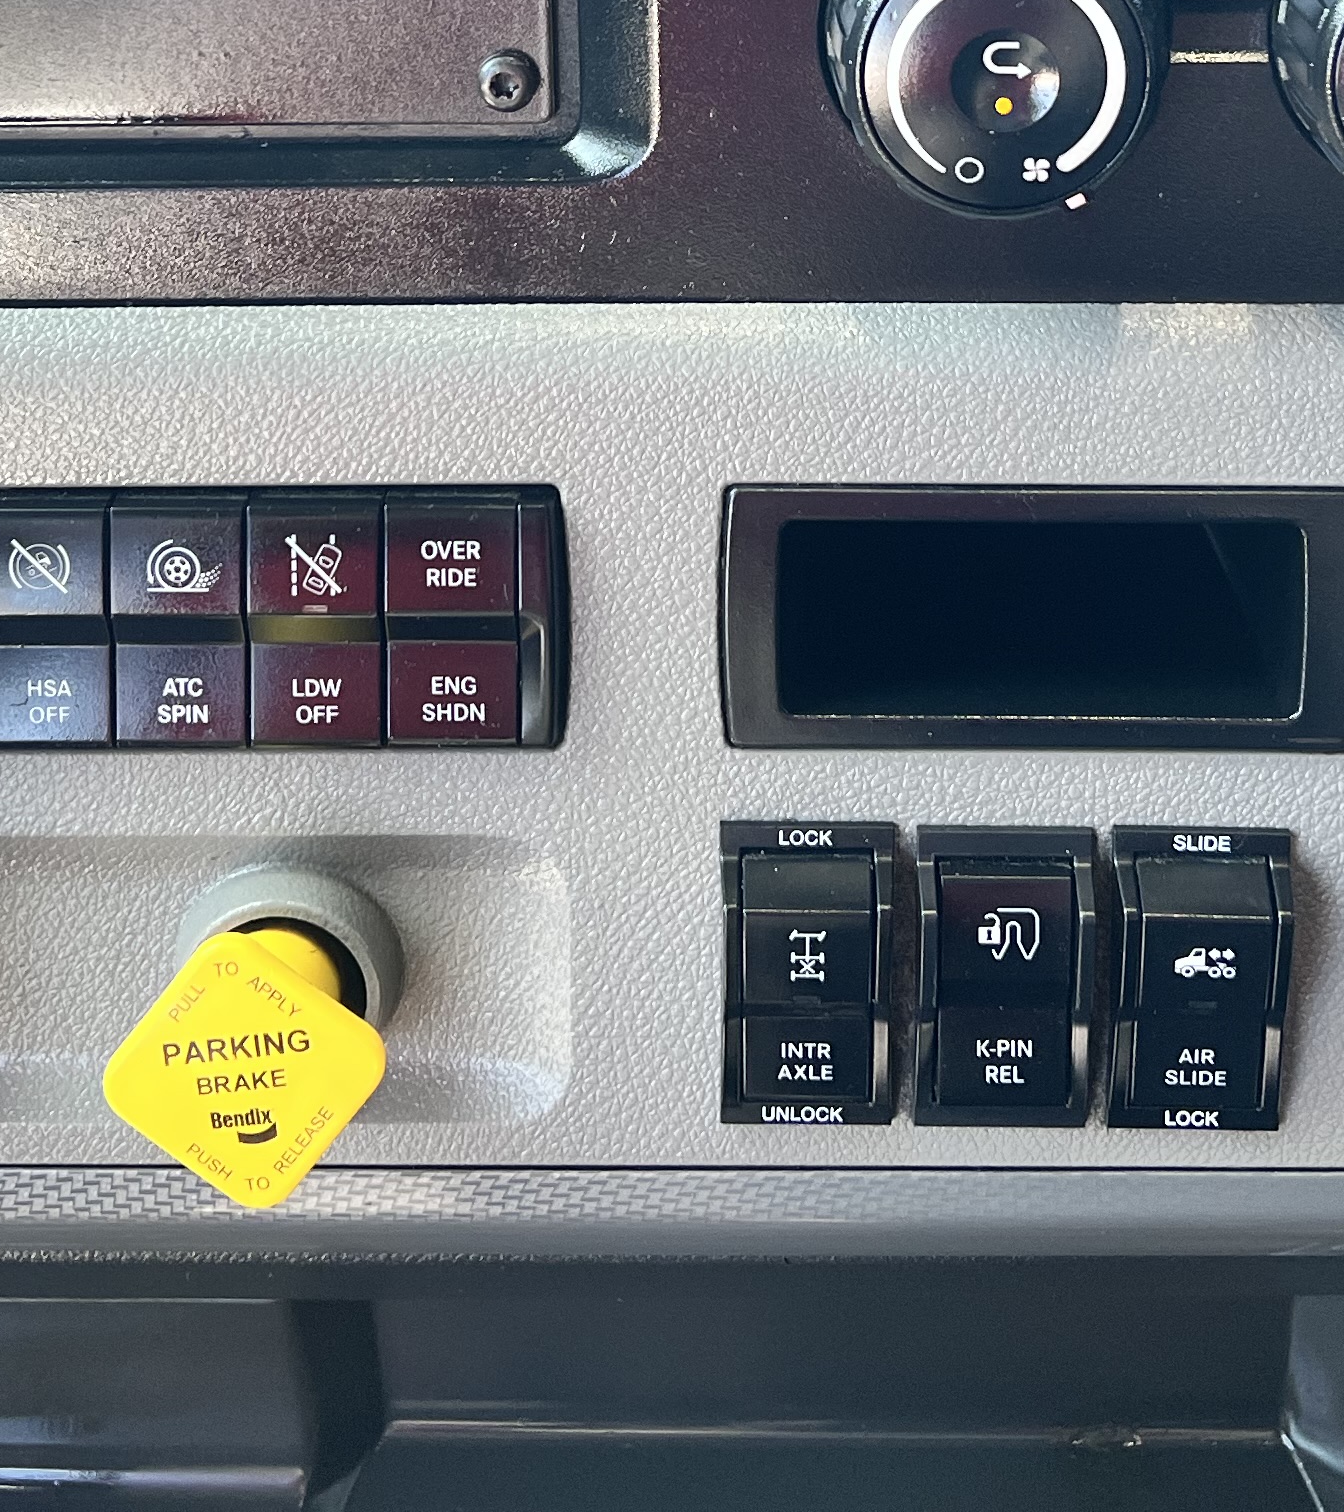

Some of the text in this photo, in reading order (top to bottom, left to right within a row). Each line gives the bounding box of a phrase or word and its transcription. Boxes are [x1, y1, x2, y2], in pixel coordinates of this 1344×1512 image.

[420, 541, 481, 560] OVER
[426, 569, 477, 587] RIDE
[27, 679, 72, 698] HSA
[162, 678, 203, 698] ATC
[292, 679, 342, 698] LDW
[431, 676, 477, 695] ENG
[29, 706, 71, 724] OFF
[157, 704, 209, 724] SPIN
[295, 705, 339, 724] OFF
[422, 703, 486, 722] SHDN
[777, 829, 834, 848] LOCK
[1172, 834, 1232, 854] SLIDE
[168, 961, 302, 1023] PULL TO APPLY
[162, 1029, 311, 1066] PARKING
[780, 1042, 832, 1060] INTR
[975, 1039, 1033, 1059] K-PIN
[1178, 1048, 1216, 1066] AIR
[196, 1068, 287, 1095] BRAKE
[777, 1063, 834, 1082] AXLE
[985, 1065, 1025, 1085] REL
[1164, 1069, 1227, 1088] SLIDE
[210, 1108, 274, 1129] Bendix
[760, 1105, 844, 1124] UNLOCK
[1164, 1110, 1220, 1129] LOCK
[186, 1105, 334, 1192] PUSH TO RELEASE
